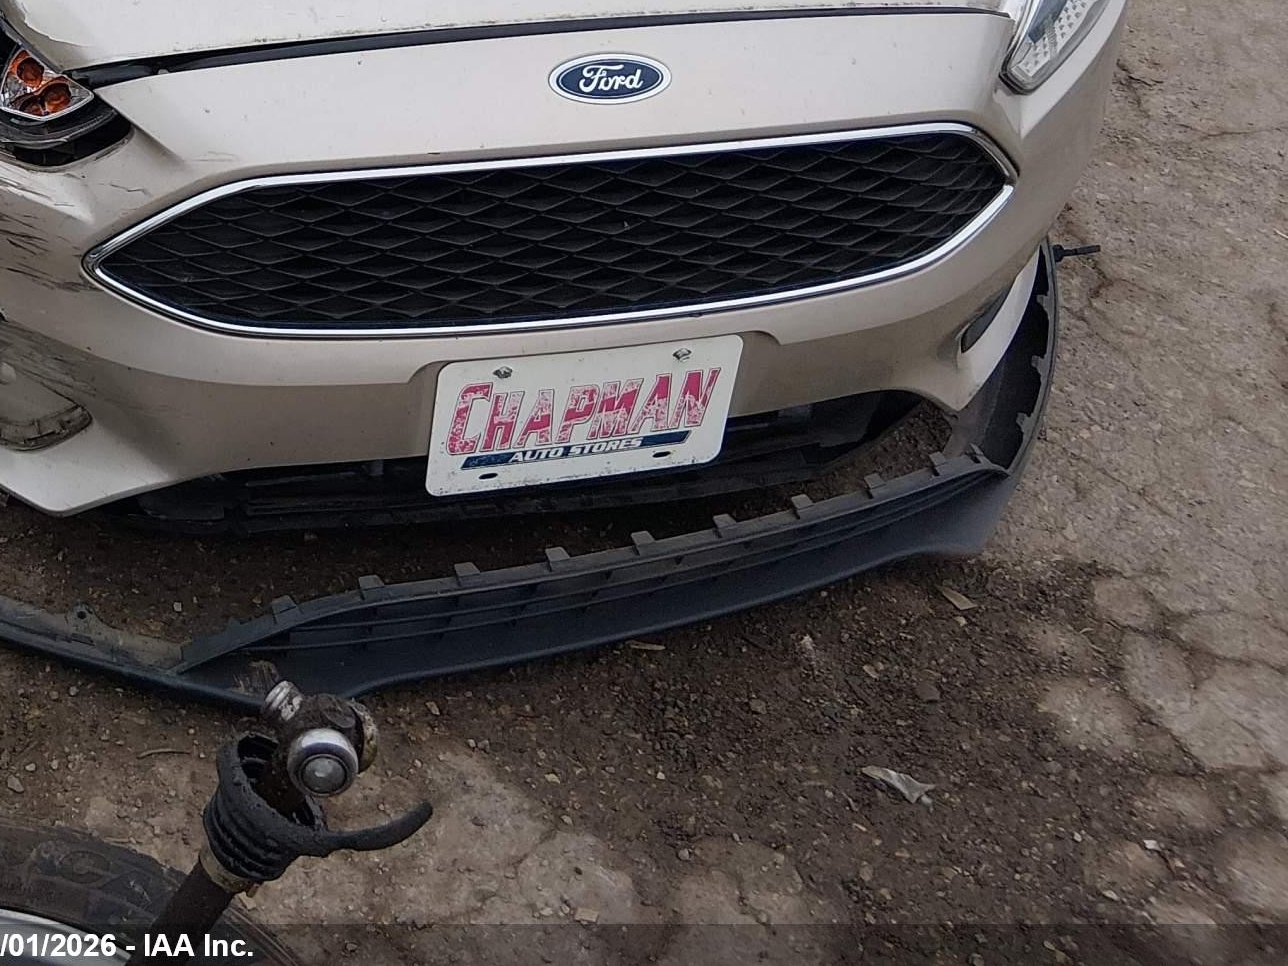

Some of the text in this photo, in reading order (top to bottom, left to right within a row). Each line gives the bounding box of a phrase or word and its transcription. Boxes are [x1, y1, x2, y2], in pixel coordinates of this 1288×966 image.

[578, 64, 644, 93] Ford
[446, 366, 722, 457] CHAPMAN
[508, 436, 643, 464] AUTO STORES
